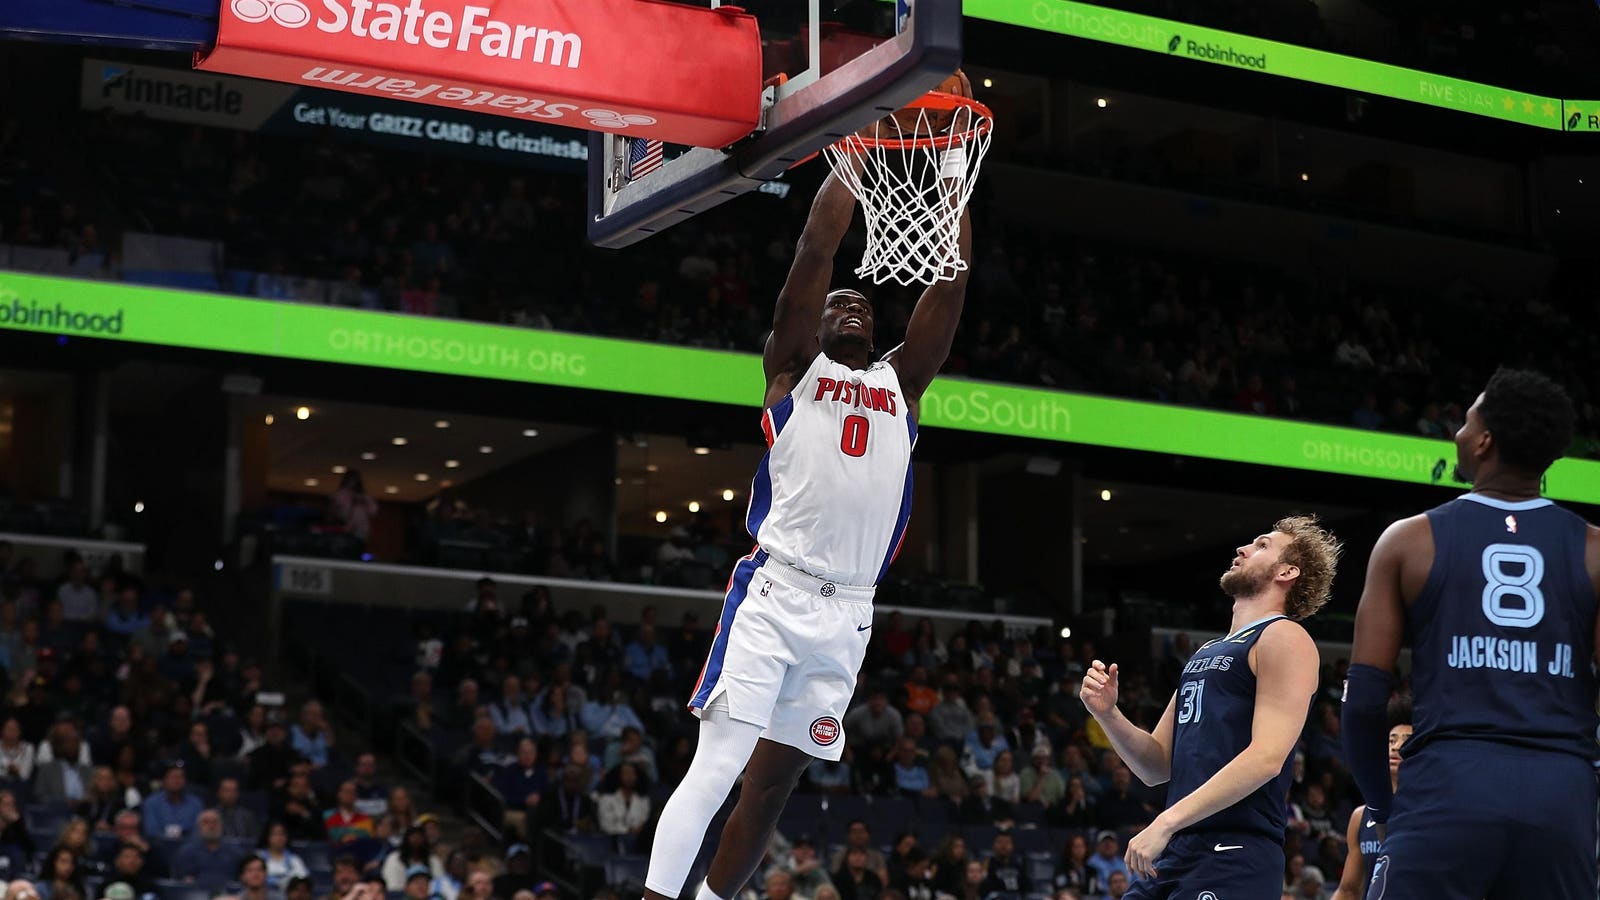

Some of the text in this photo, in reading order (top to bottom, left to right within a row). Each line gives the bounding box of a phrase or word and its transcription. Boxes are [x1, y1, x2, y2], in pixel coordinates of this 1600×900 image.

[1186, 40, 1266, 70] Robinhood
[103, 66, 242, 115] Pinnacle
[1419, 81, 1454, 102] FIVE
[294, 103, 325, 126] Get
[329, 108, 367, 131] Your
[369, 112, 424, 138] GRIZZ
[426, 120, 475, 144] CARD
[476, 130, 494, 147] at
[329, 328, 587, 376] ORTHOSOUTH.ORG
[814, 376, 897, 417] PISTONS
[840, 415, 870, 458] 0
[1481, 543, 1545, 628] 8
[1447, 635, 1575, 678] JACKSON JR.
[1178, 678, 1206, 724] 31
